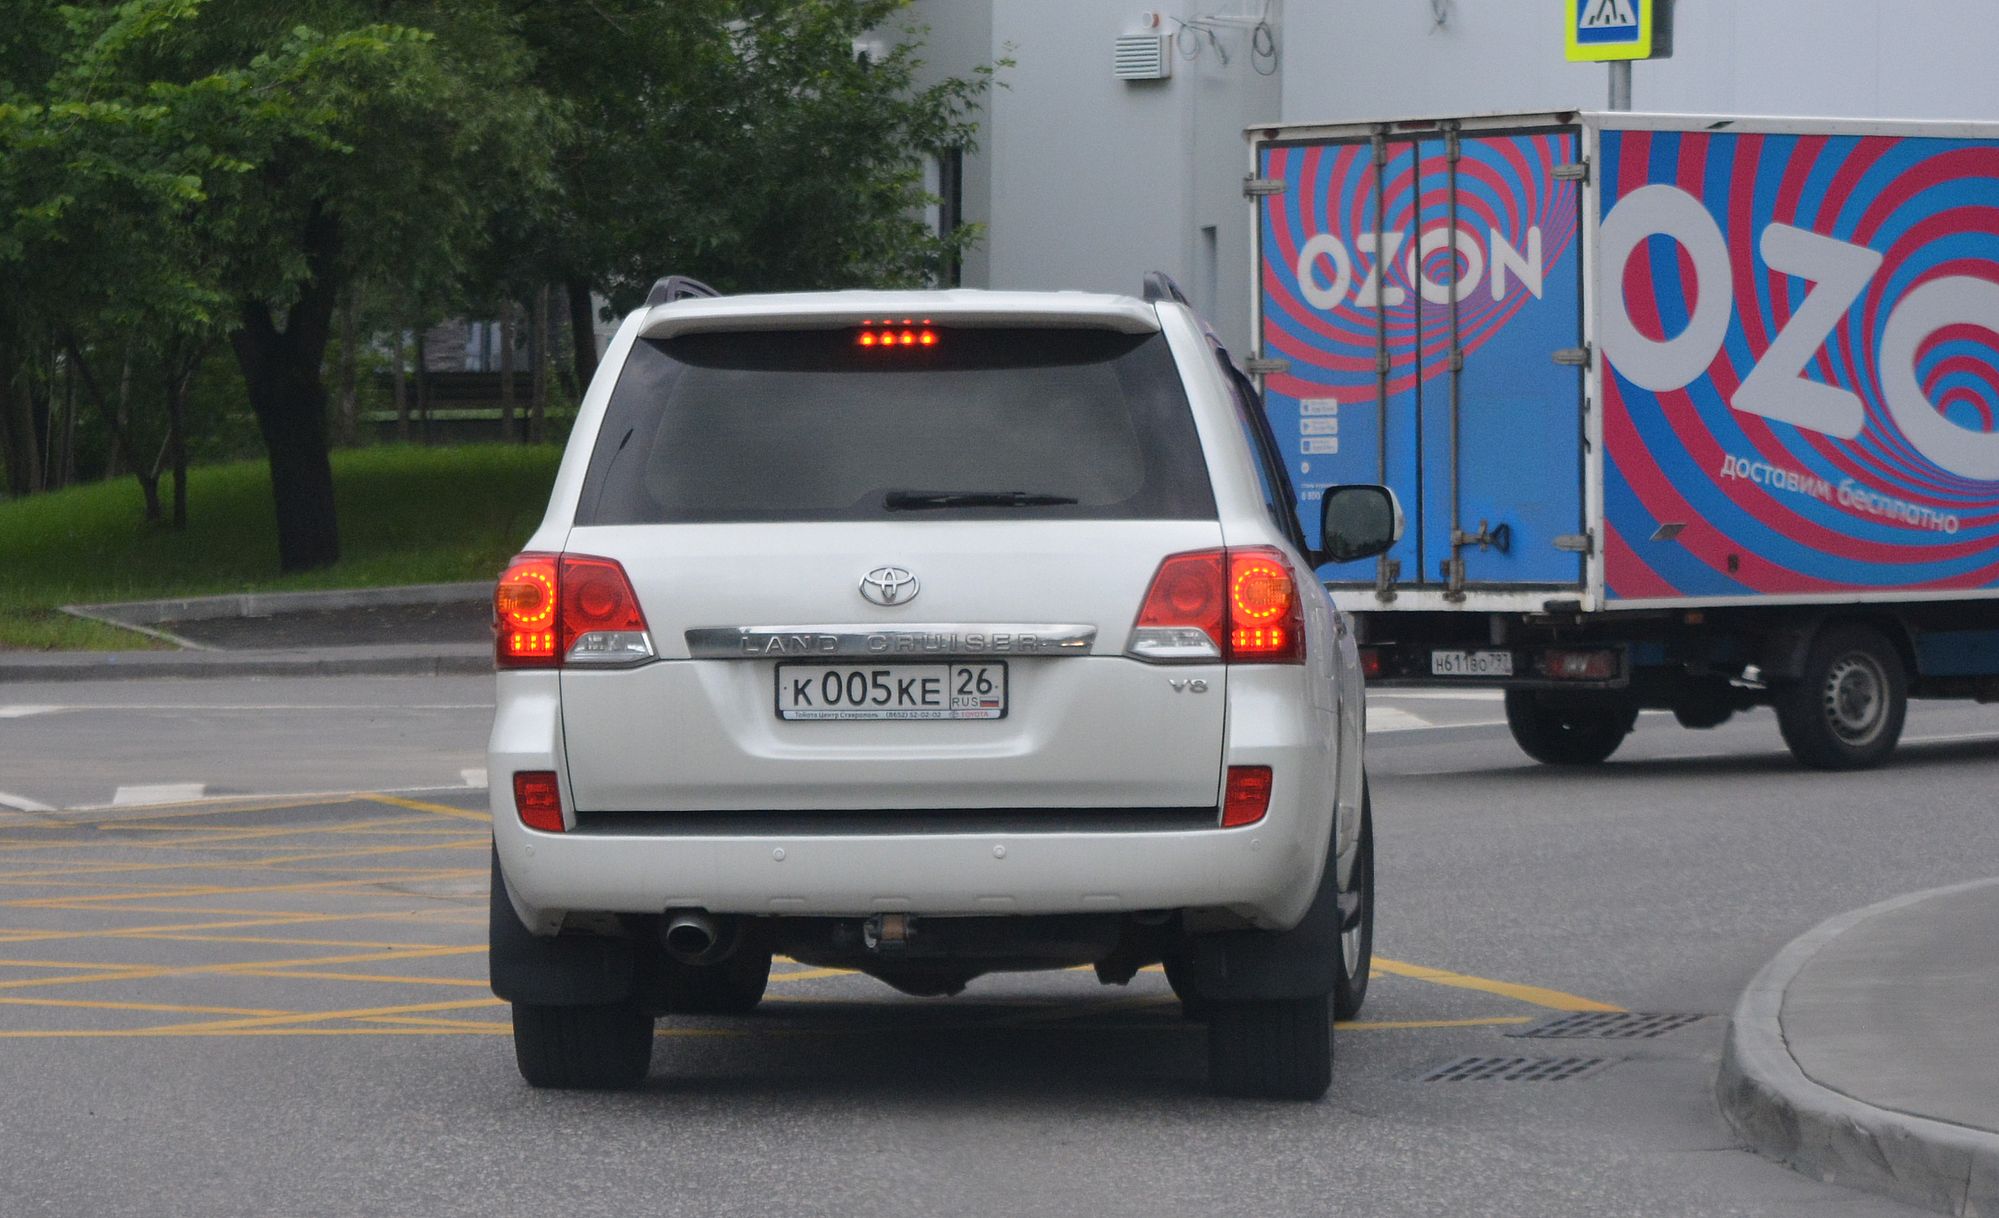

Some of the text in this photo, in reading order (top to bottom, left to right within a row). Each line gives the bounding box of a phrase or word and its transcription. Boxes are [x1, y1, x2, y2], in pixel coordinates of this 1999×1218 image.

[1297, 226, 1543, 310] OZON
[1720, 454, 1960, 534] доставим бесплатно
[740, 632, 1040, 655] LAND CRUISER
[957, 668, 993, 695] 26
[1168, 679, 1209, 694] V8
[951, 697, 978, 707] RUS
